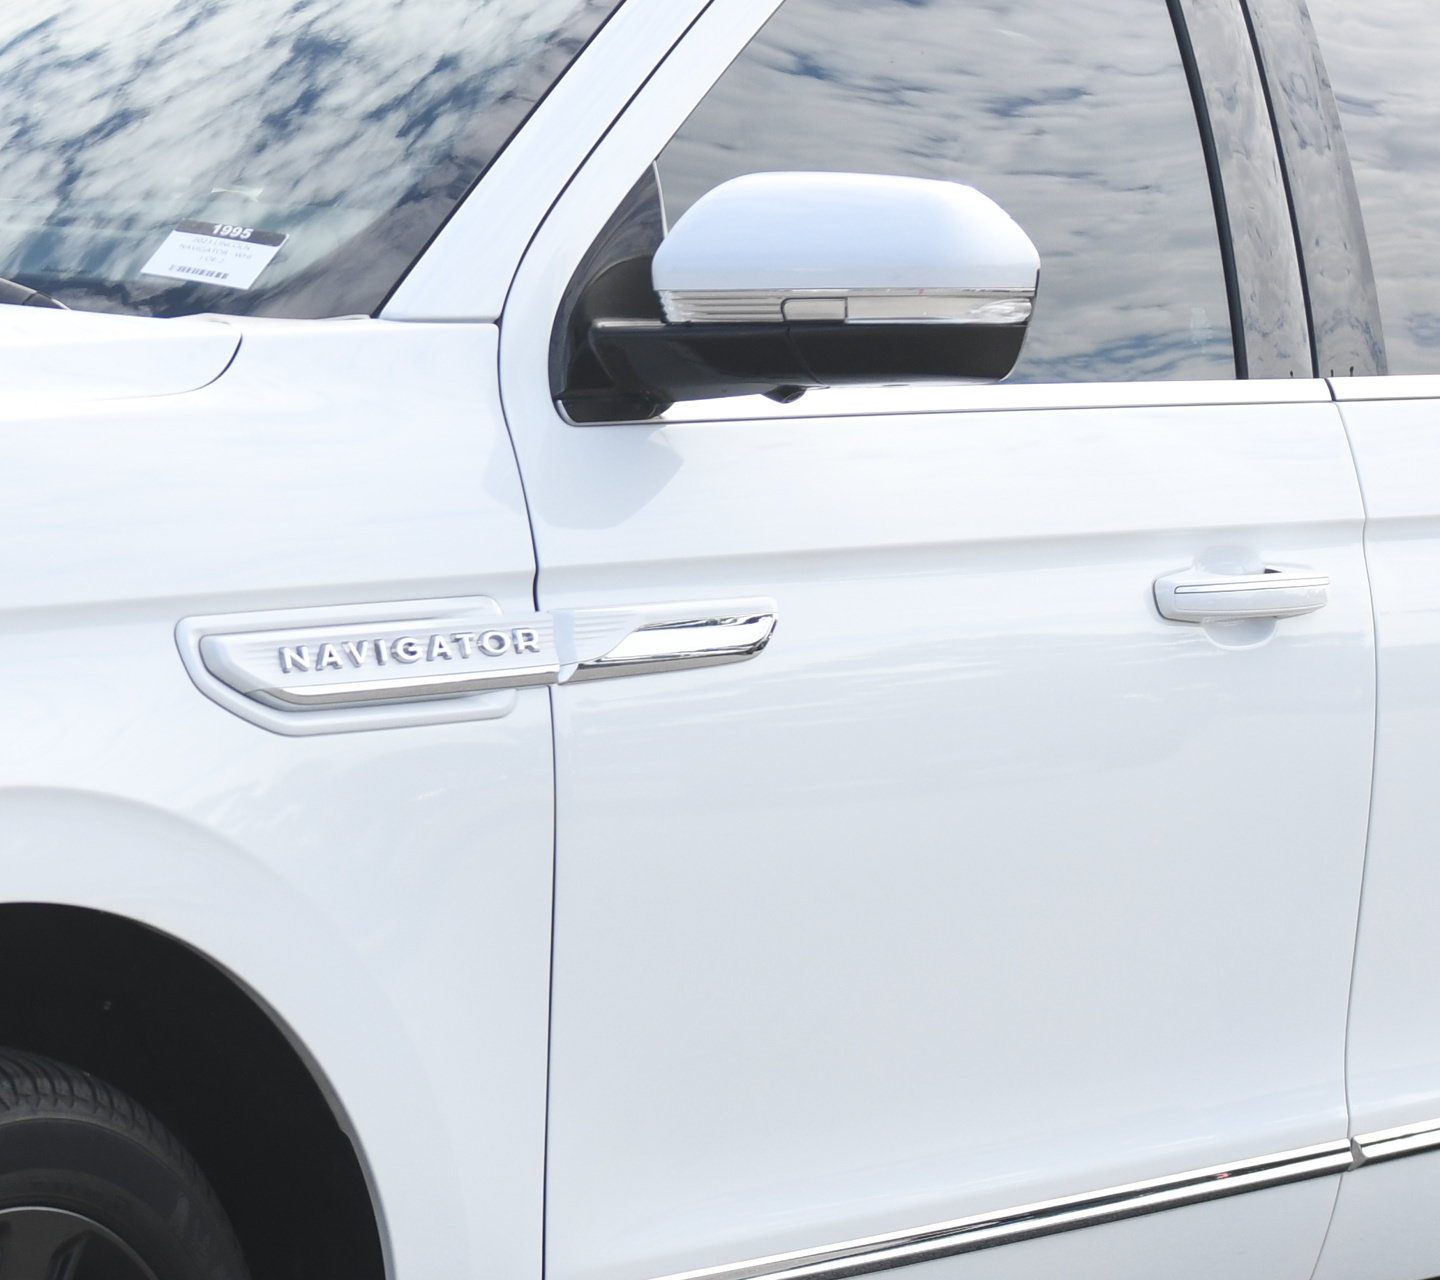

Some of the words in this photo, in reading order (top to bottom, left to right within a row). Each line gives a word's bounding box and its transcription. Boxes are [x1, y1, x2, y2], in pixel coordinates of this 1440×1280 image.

[212, 223, 254, 239] 1995
[178, 243, 229, 255] NAVIGATOR
[213, 238, 251, 251] LINCOLN
[278, 627, 541, 674] NAVIGATOR
